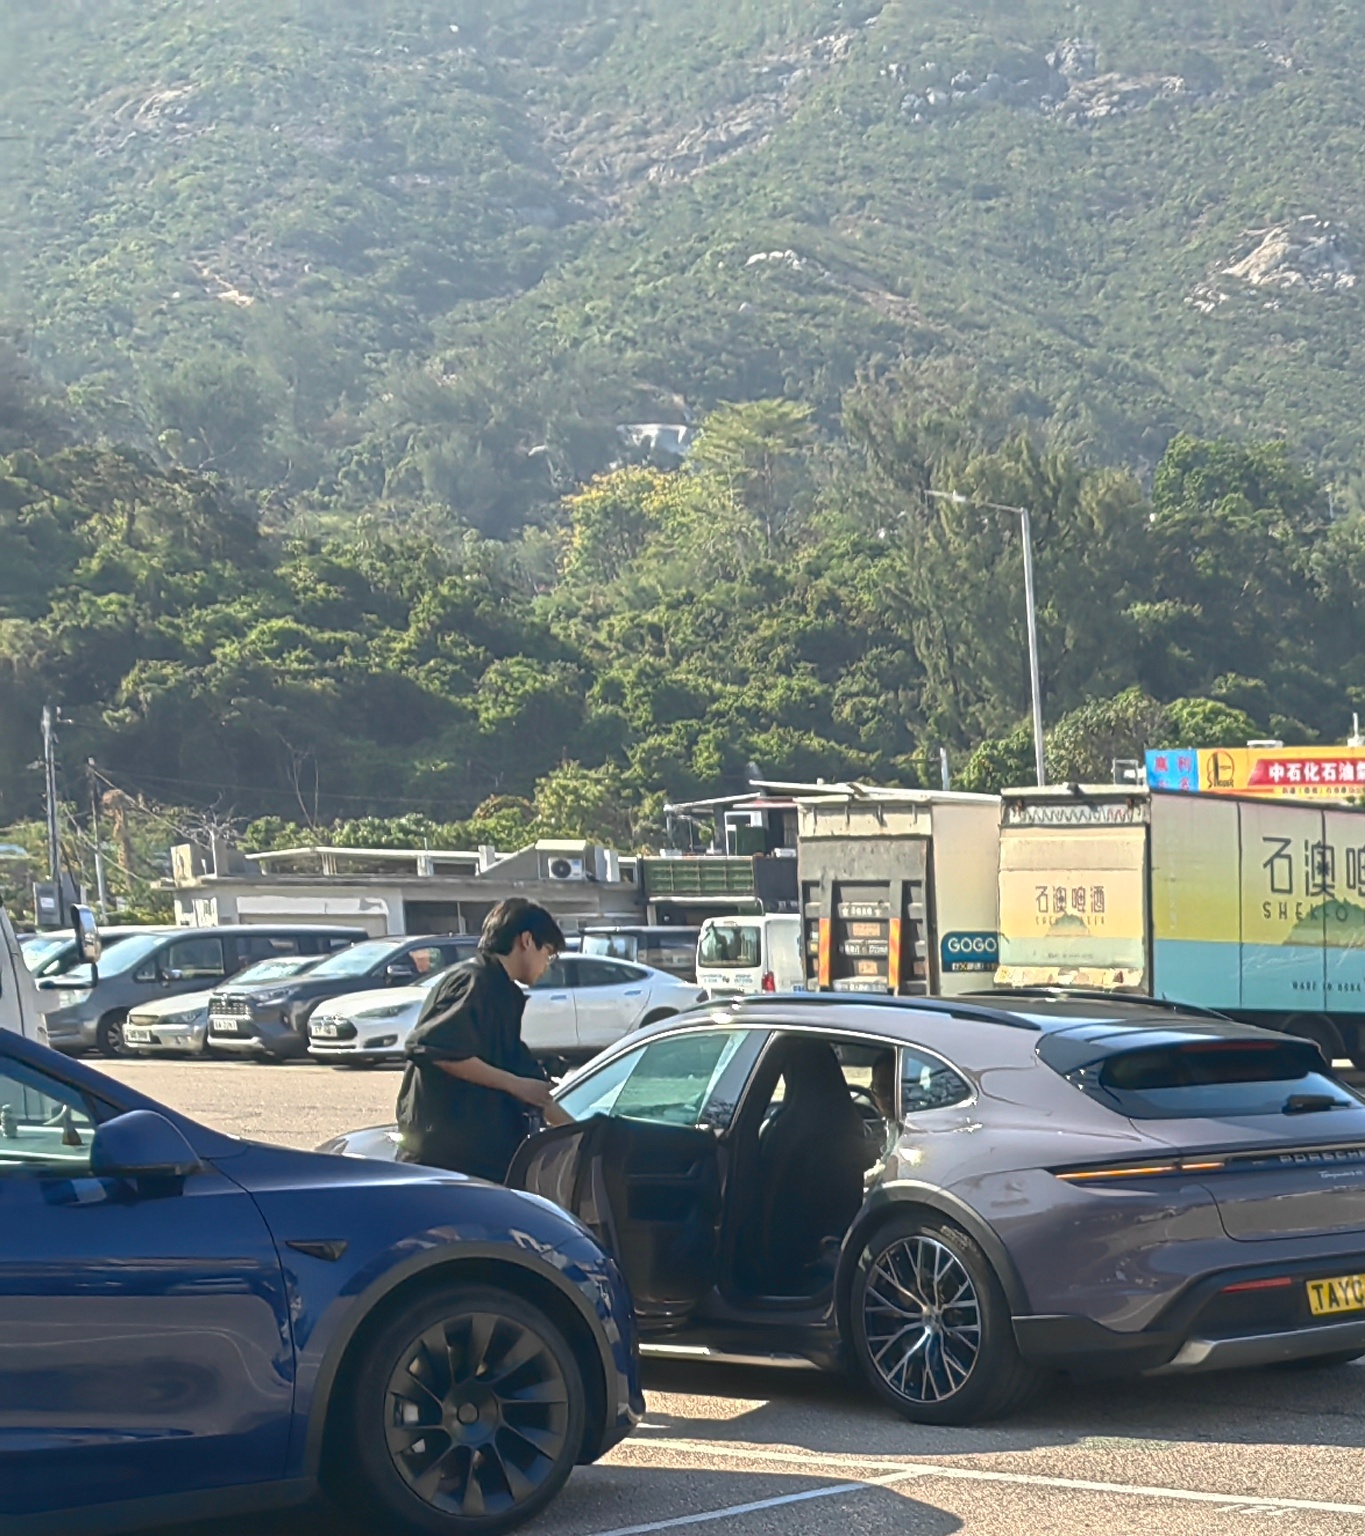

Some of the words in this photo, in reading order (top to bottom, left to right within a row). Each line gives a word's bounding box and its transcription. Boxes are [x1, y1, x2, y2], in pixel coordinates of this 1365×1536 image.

[1035, 885, 1106, 914] 石澳啤酒
[947, 937, 997, 952] GOGO
